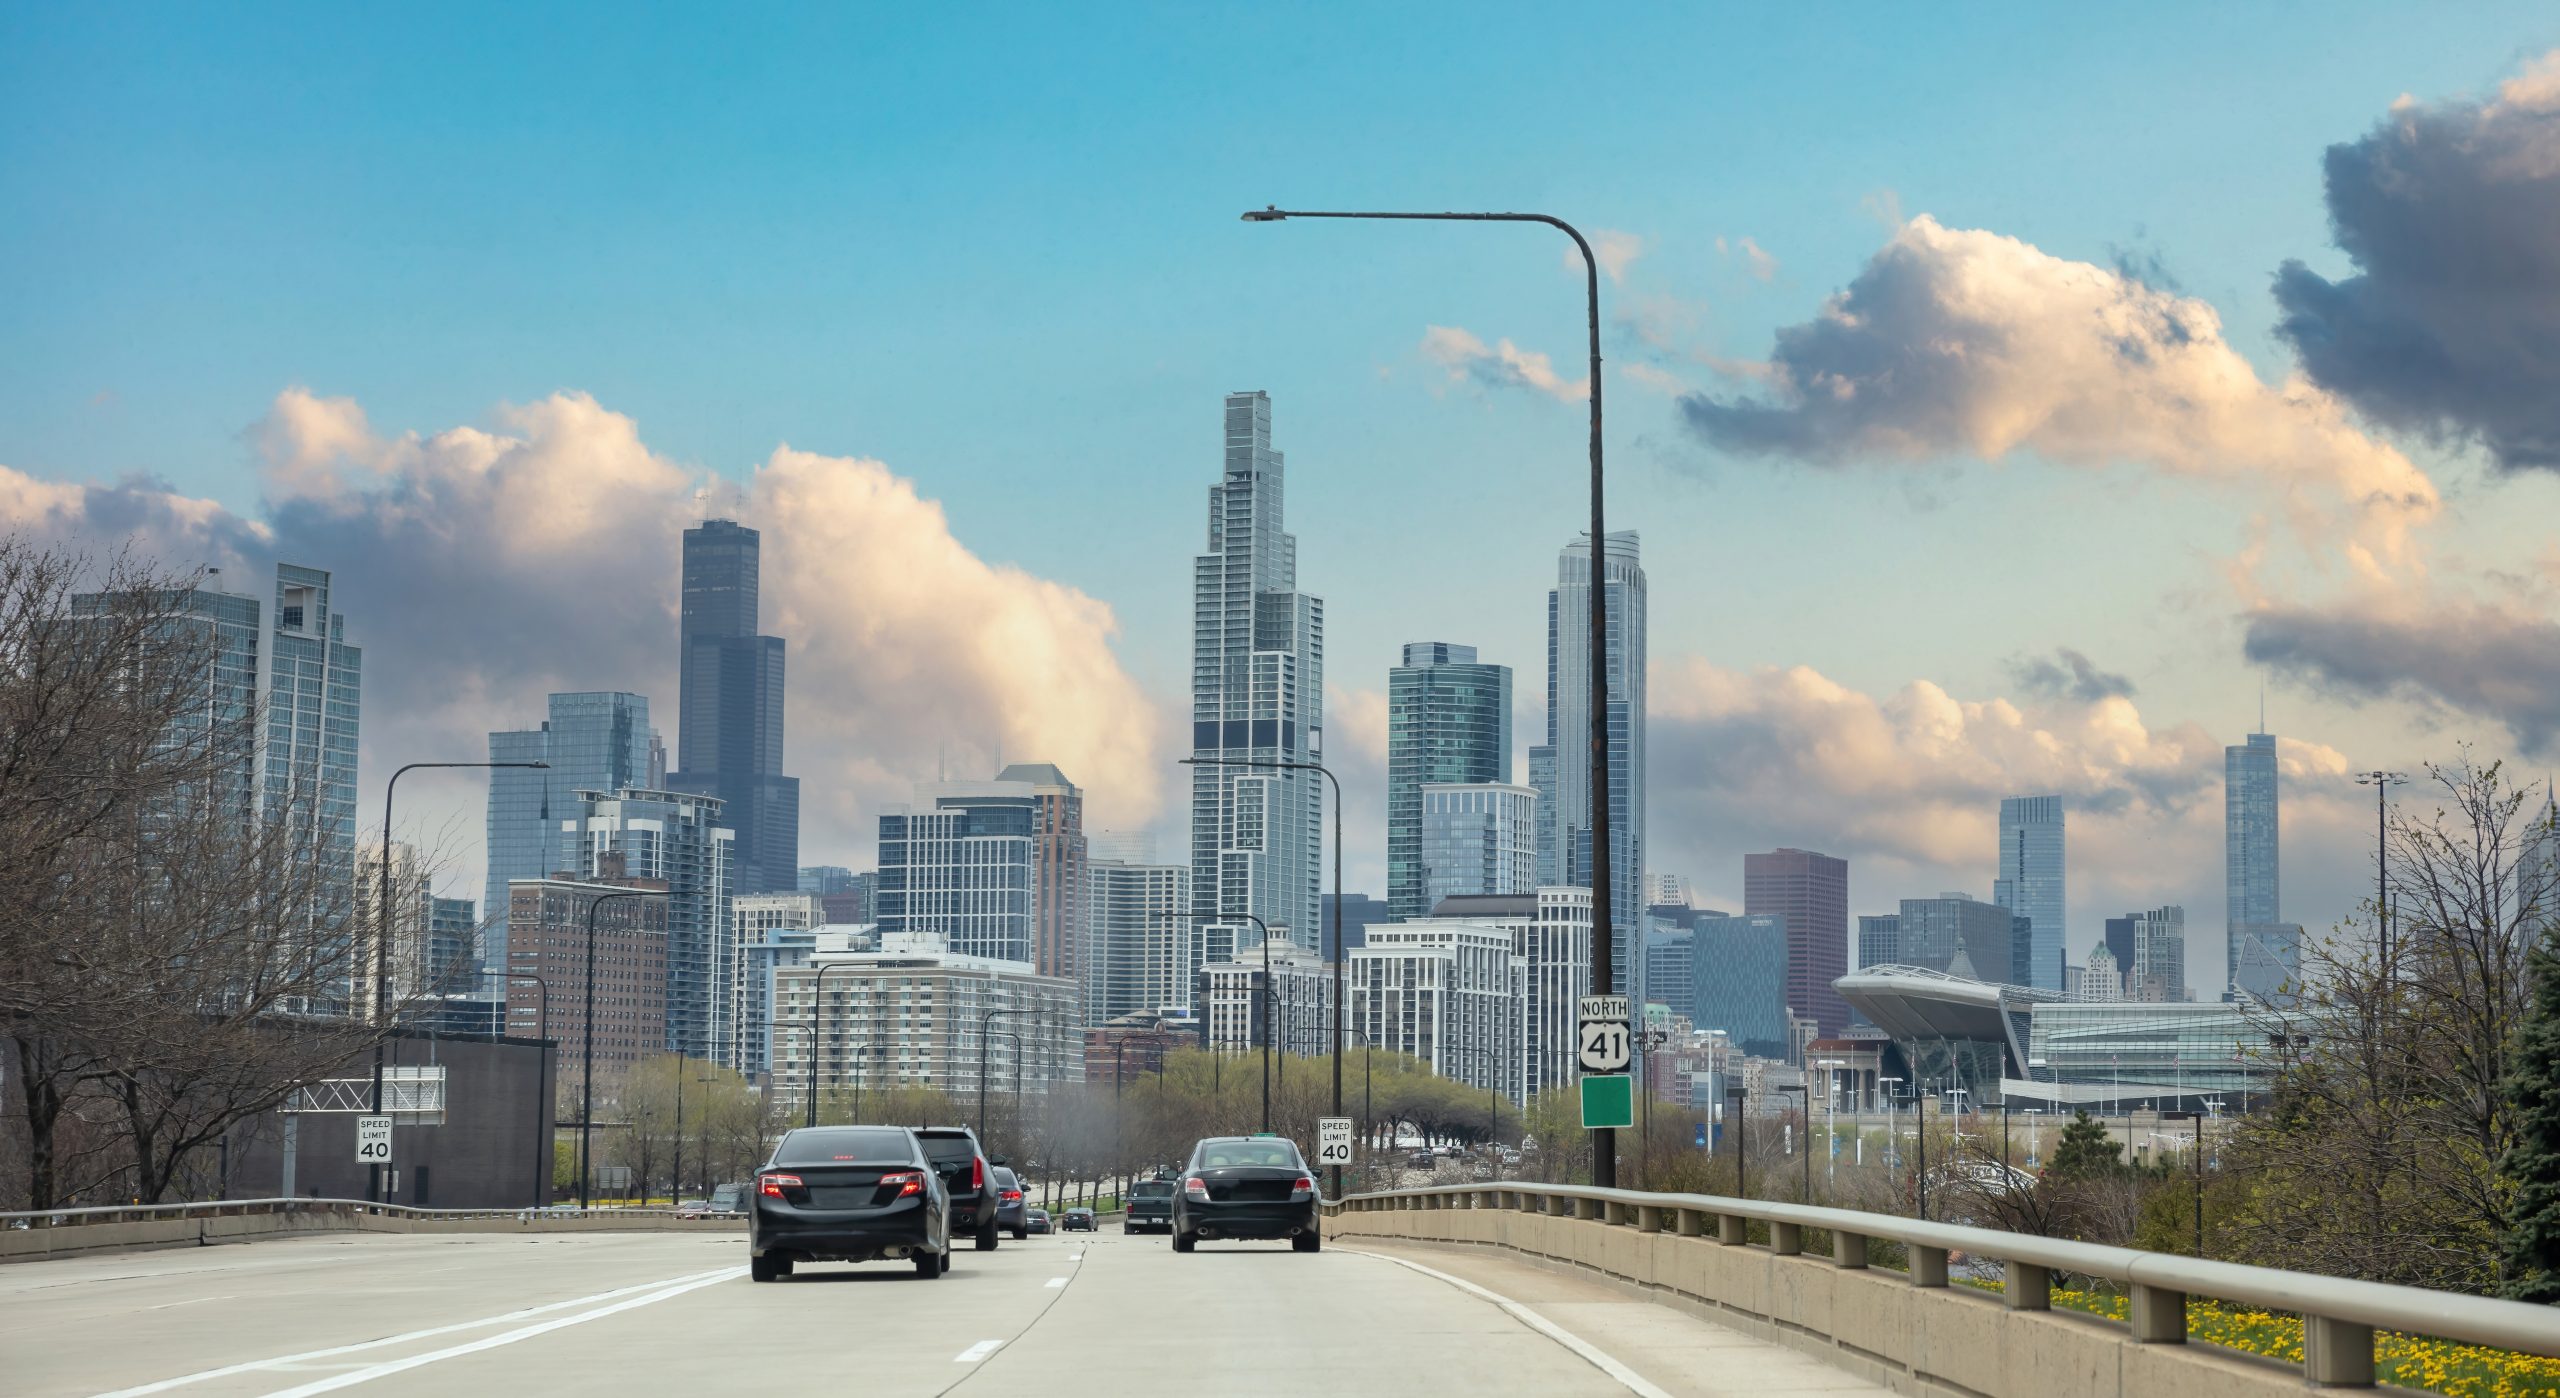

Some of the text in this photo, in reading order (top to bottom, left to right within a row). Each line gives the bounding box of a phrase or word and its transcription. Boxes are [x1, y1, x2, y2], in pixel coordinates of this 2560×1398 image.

[1581, 1001, 1627, 1016] NORTH
[1587, 1032, 1620, 1060] 41
[360, 1120, 391, 1128] SPEED
[1321, 1122, 1350, 1130] SPEED
[362, 1131, 387, 1139] LIMIT
[1323, 1133, 1347, 1141] LIMIT
[360, 1142, 389, 1158] 40
[1322, 1144, 1349, 1160] 40
